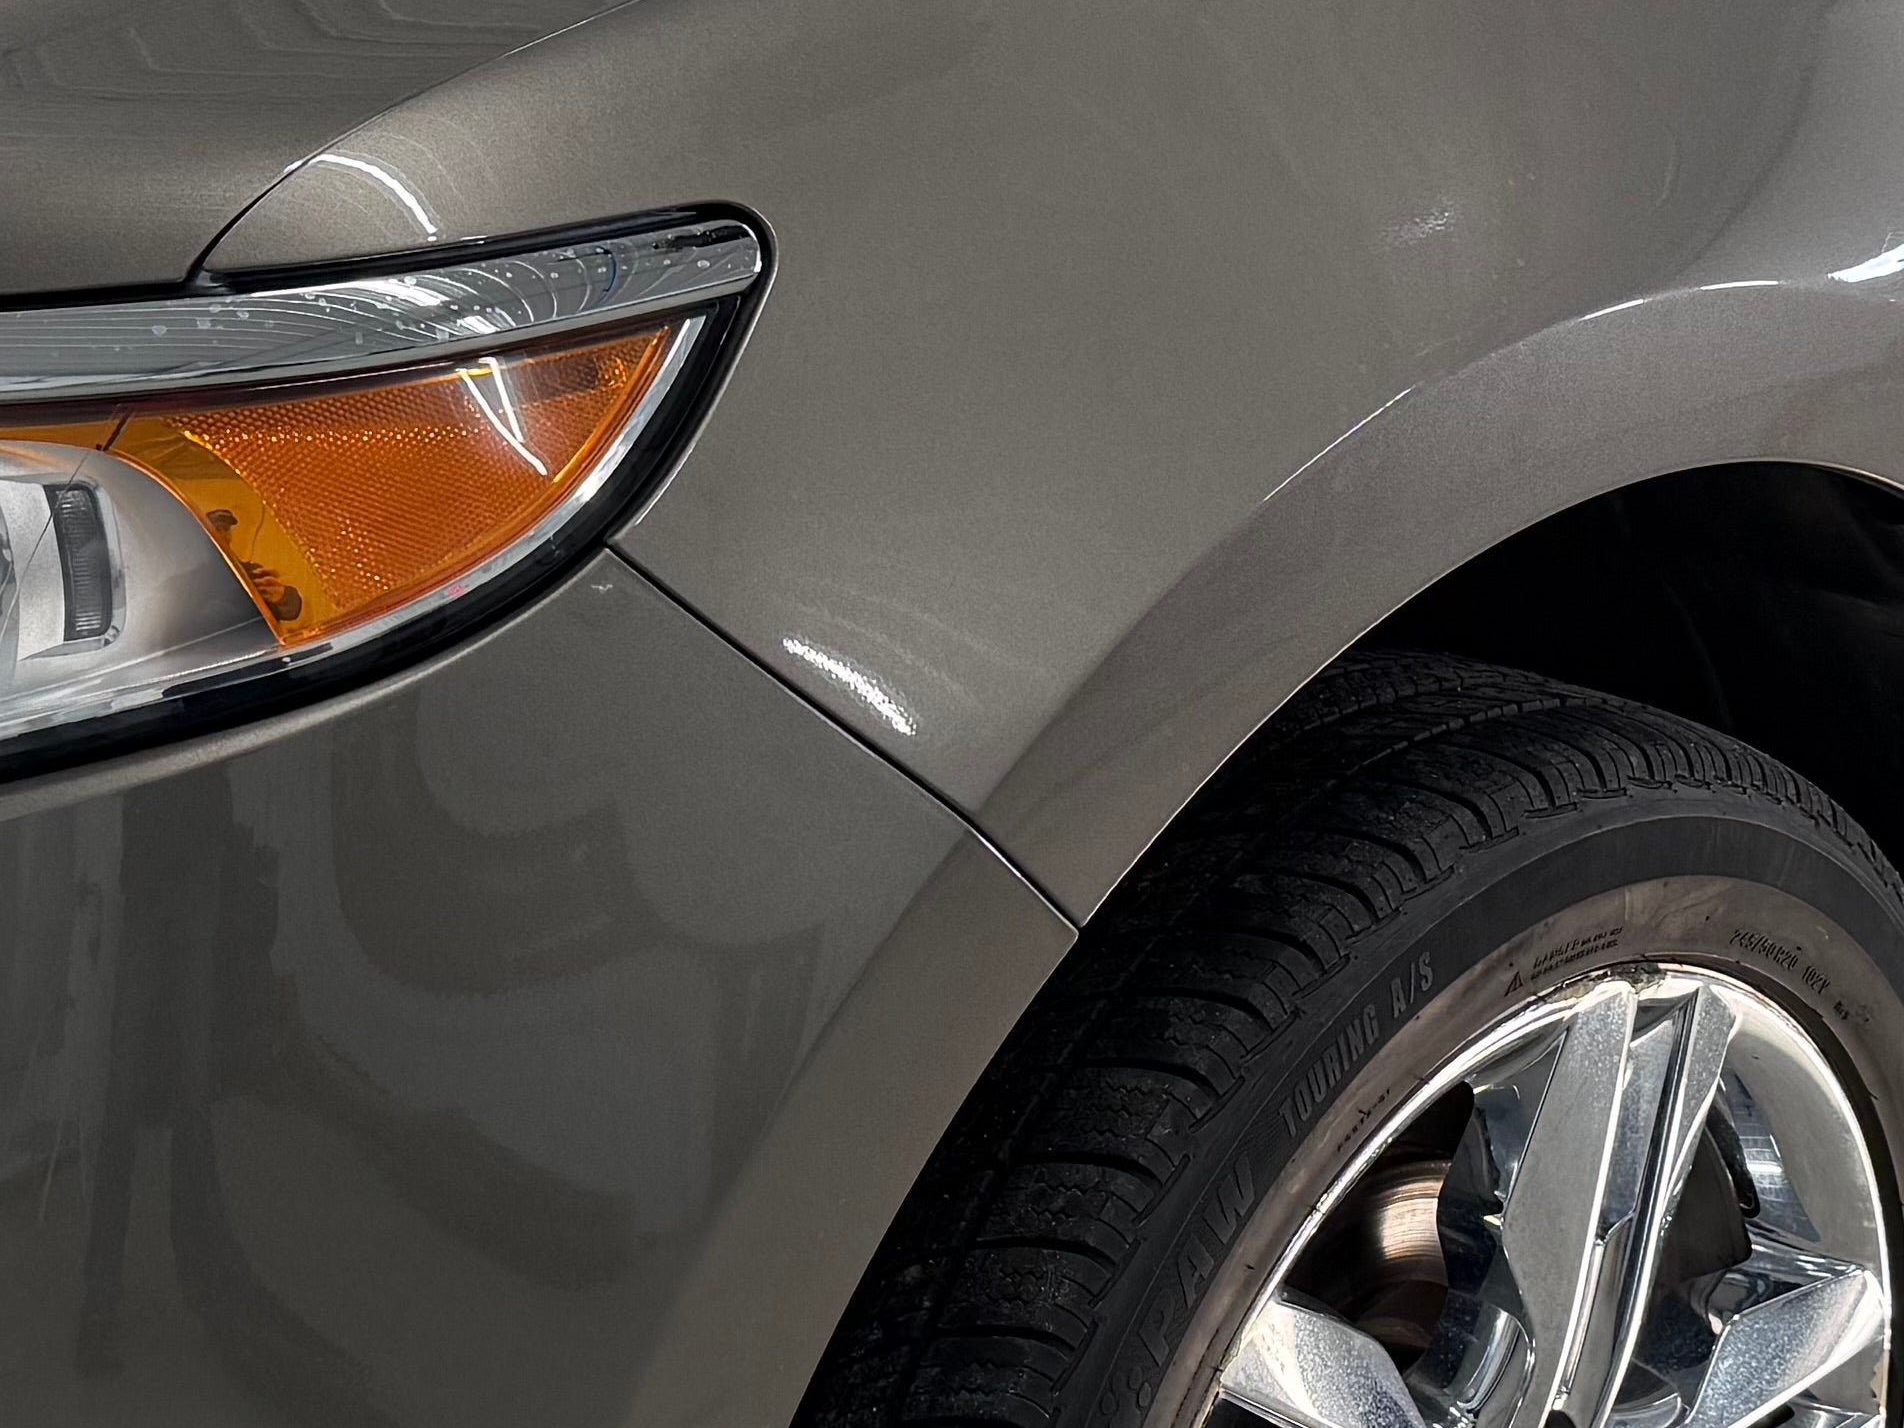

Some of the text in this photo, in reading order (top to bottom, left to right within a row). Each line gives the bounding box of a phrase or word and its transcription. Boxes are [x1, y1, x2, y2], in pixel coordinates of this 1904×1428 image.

[1278, 1003, 1380, 1139] TOURING
[1390, 950, 1435, 1020] A/S
[1134, 1150, 1256, 1369] PAW
